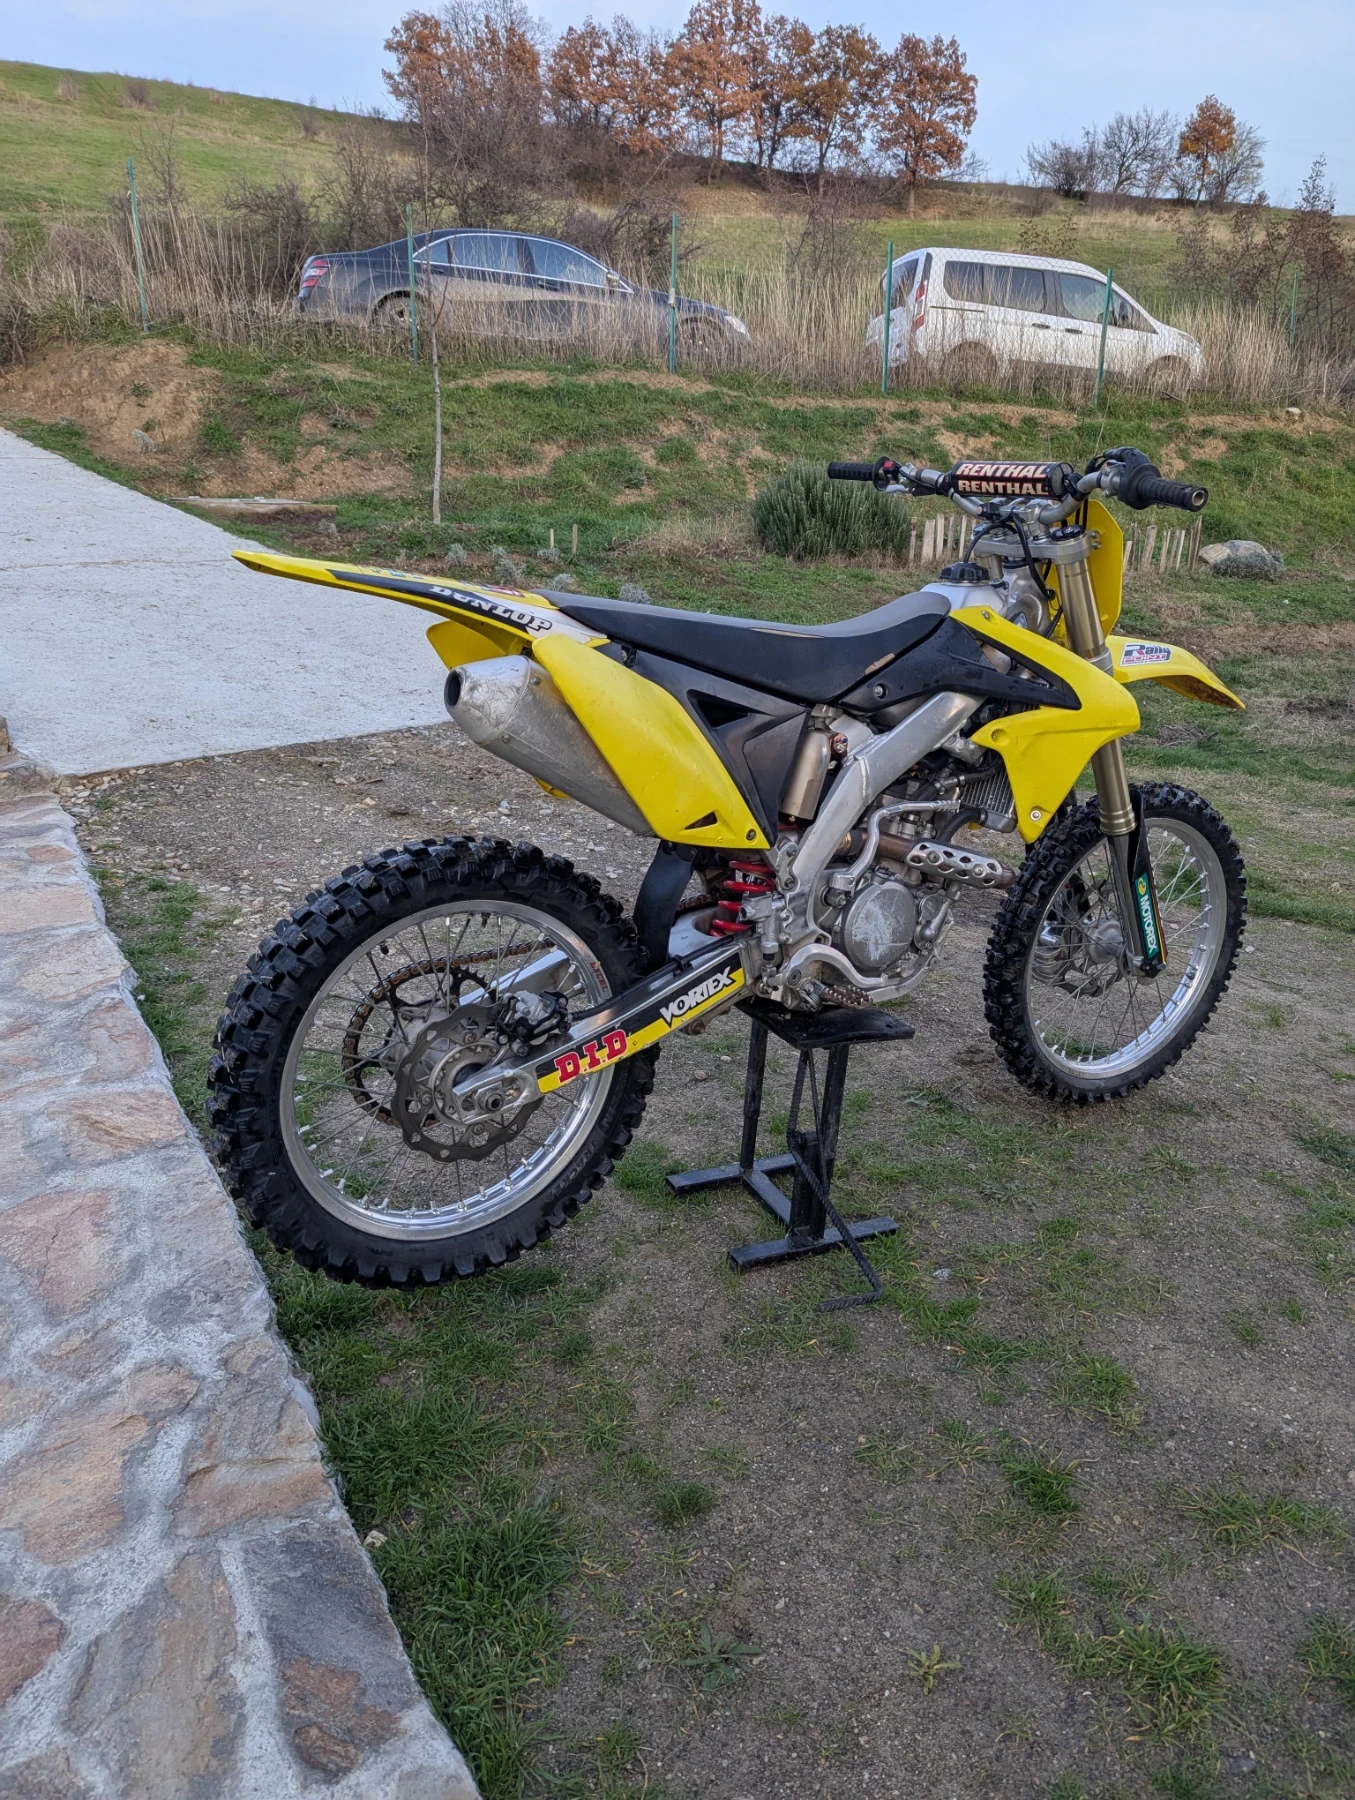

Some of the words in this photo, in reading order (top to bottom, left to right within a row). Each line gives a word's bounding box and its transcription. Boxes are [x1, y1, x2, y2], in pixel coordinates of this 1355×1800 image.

[957, 463, 1048, 479] RENTHAL
[959, 480, 1049, 495] RENTHAL
[429, 586, 553, 632] DUNLOP
[1140, 895, 1158, 953] MOTOREX
[658, 965, 736, 1024] VORTEX
